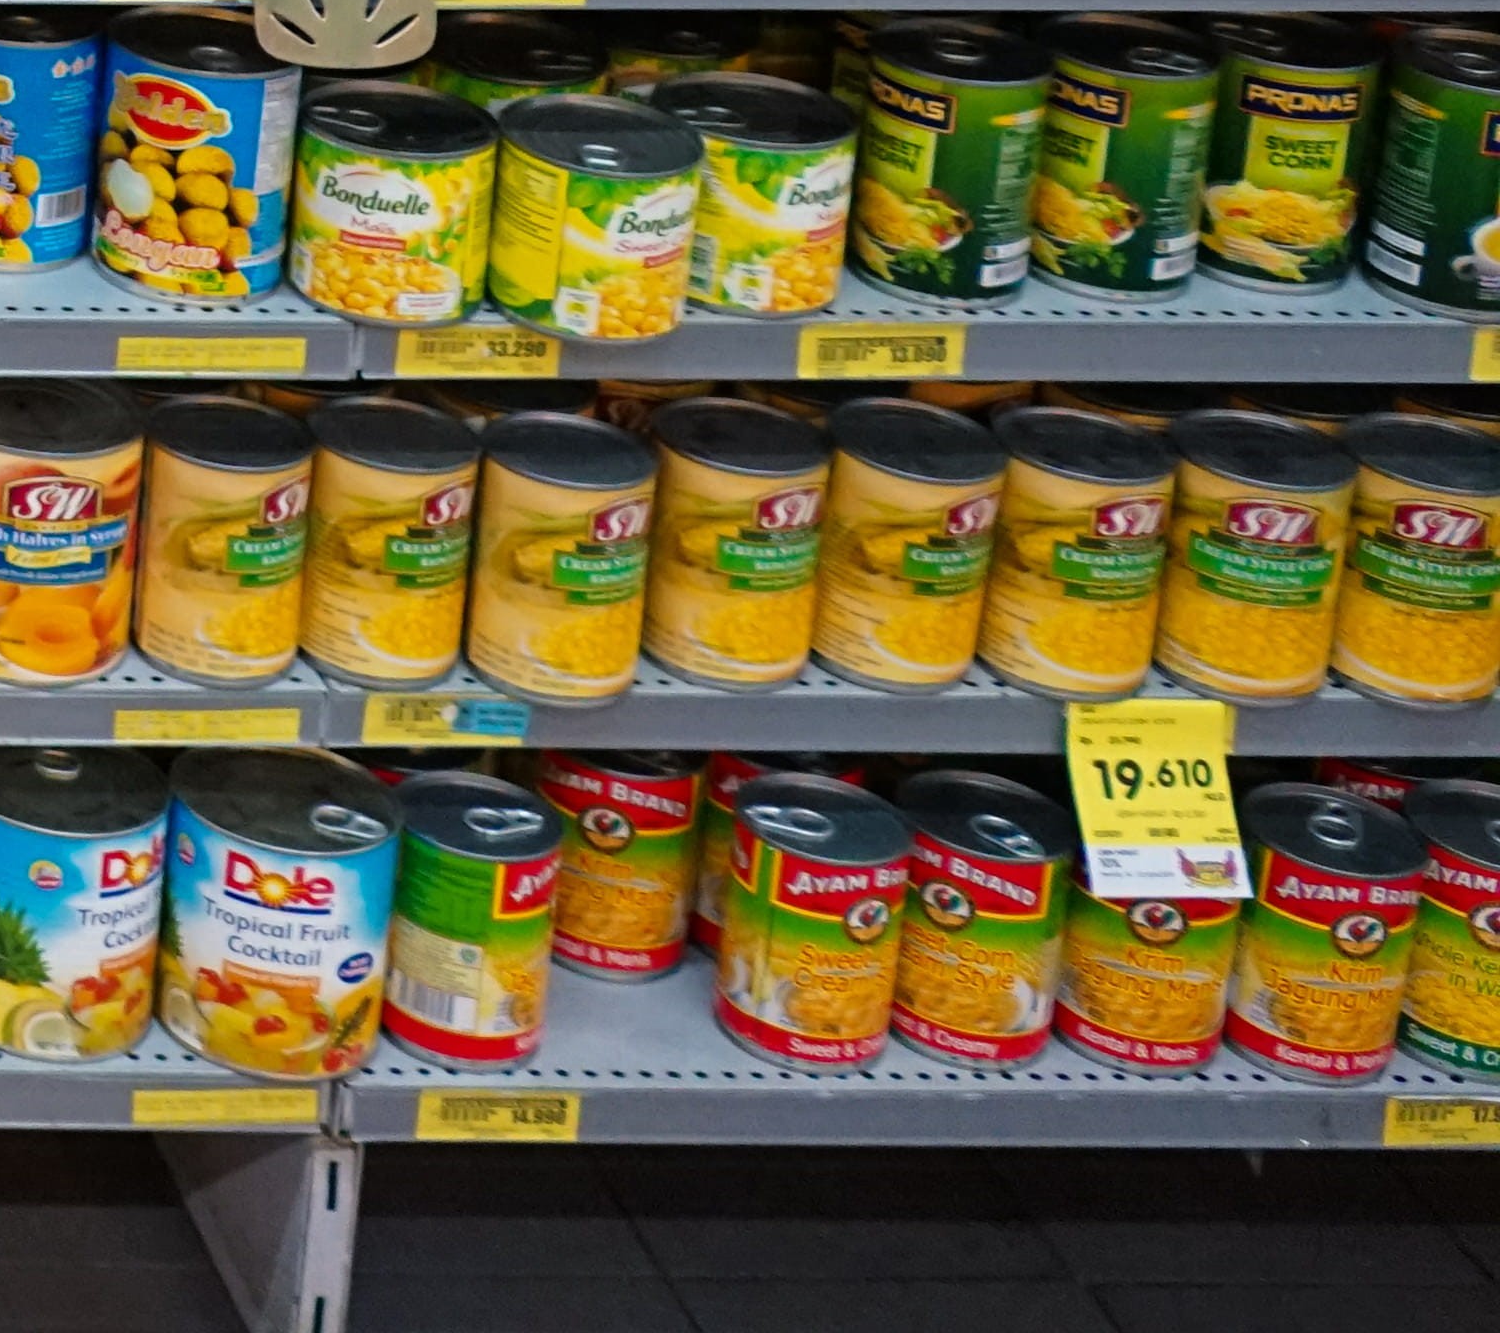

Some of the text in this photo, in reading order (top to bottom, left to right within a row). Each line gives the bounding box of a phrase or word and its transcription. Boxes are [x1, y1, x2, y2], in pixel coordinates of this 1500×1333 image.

[1249, 87, 1358, 112] PRONAS
[1266, 136, 1338, 154] SWEET
[1269, 154, 1331, 168] CORN
[322, 174, 430, 216] Bonduelle
[1094, 758, 1213, 800] 19.610
